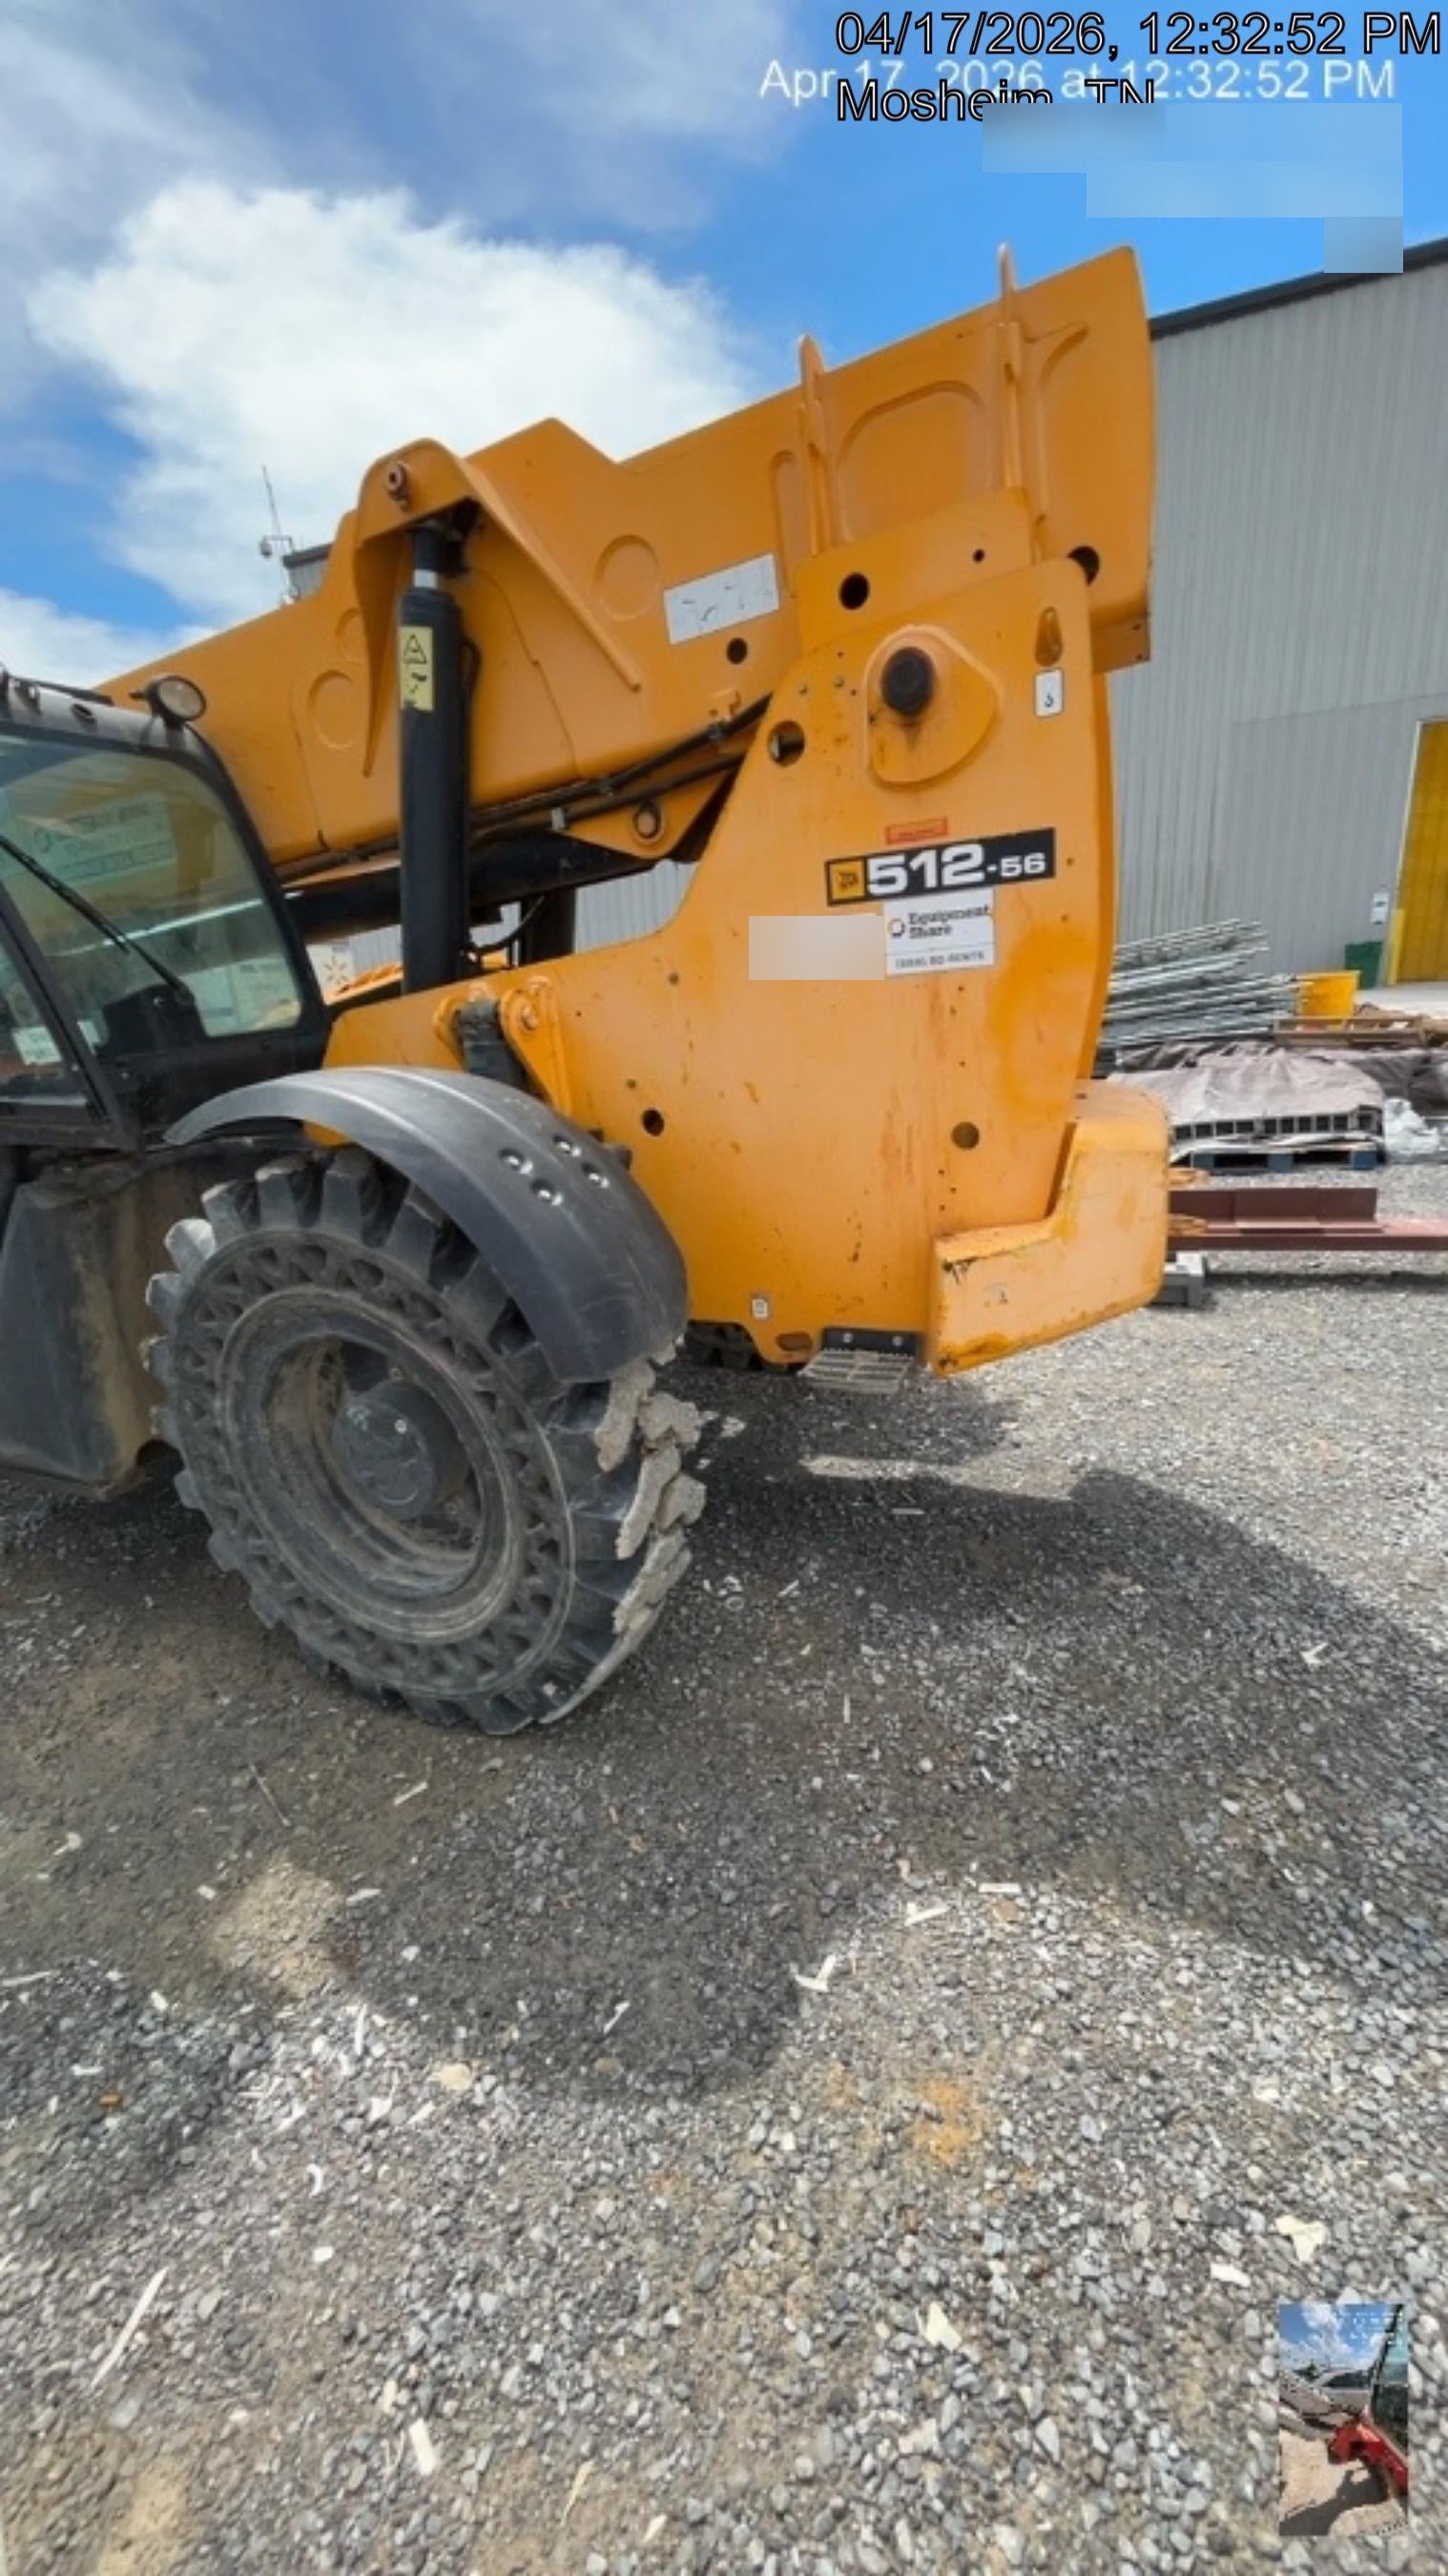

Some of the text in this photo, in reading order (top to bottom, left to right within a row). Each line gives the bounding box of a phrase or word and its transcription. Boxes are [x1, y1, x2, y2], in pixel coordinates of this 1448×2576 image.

[867, 842, 1046, 896] 512-56
[908, 904, 990, 925] Equipment
[908, 924, 952, 939] Share
